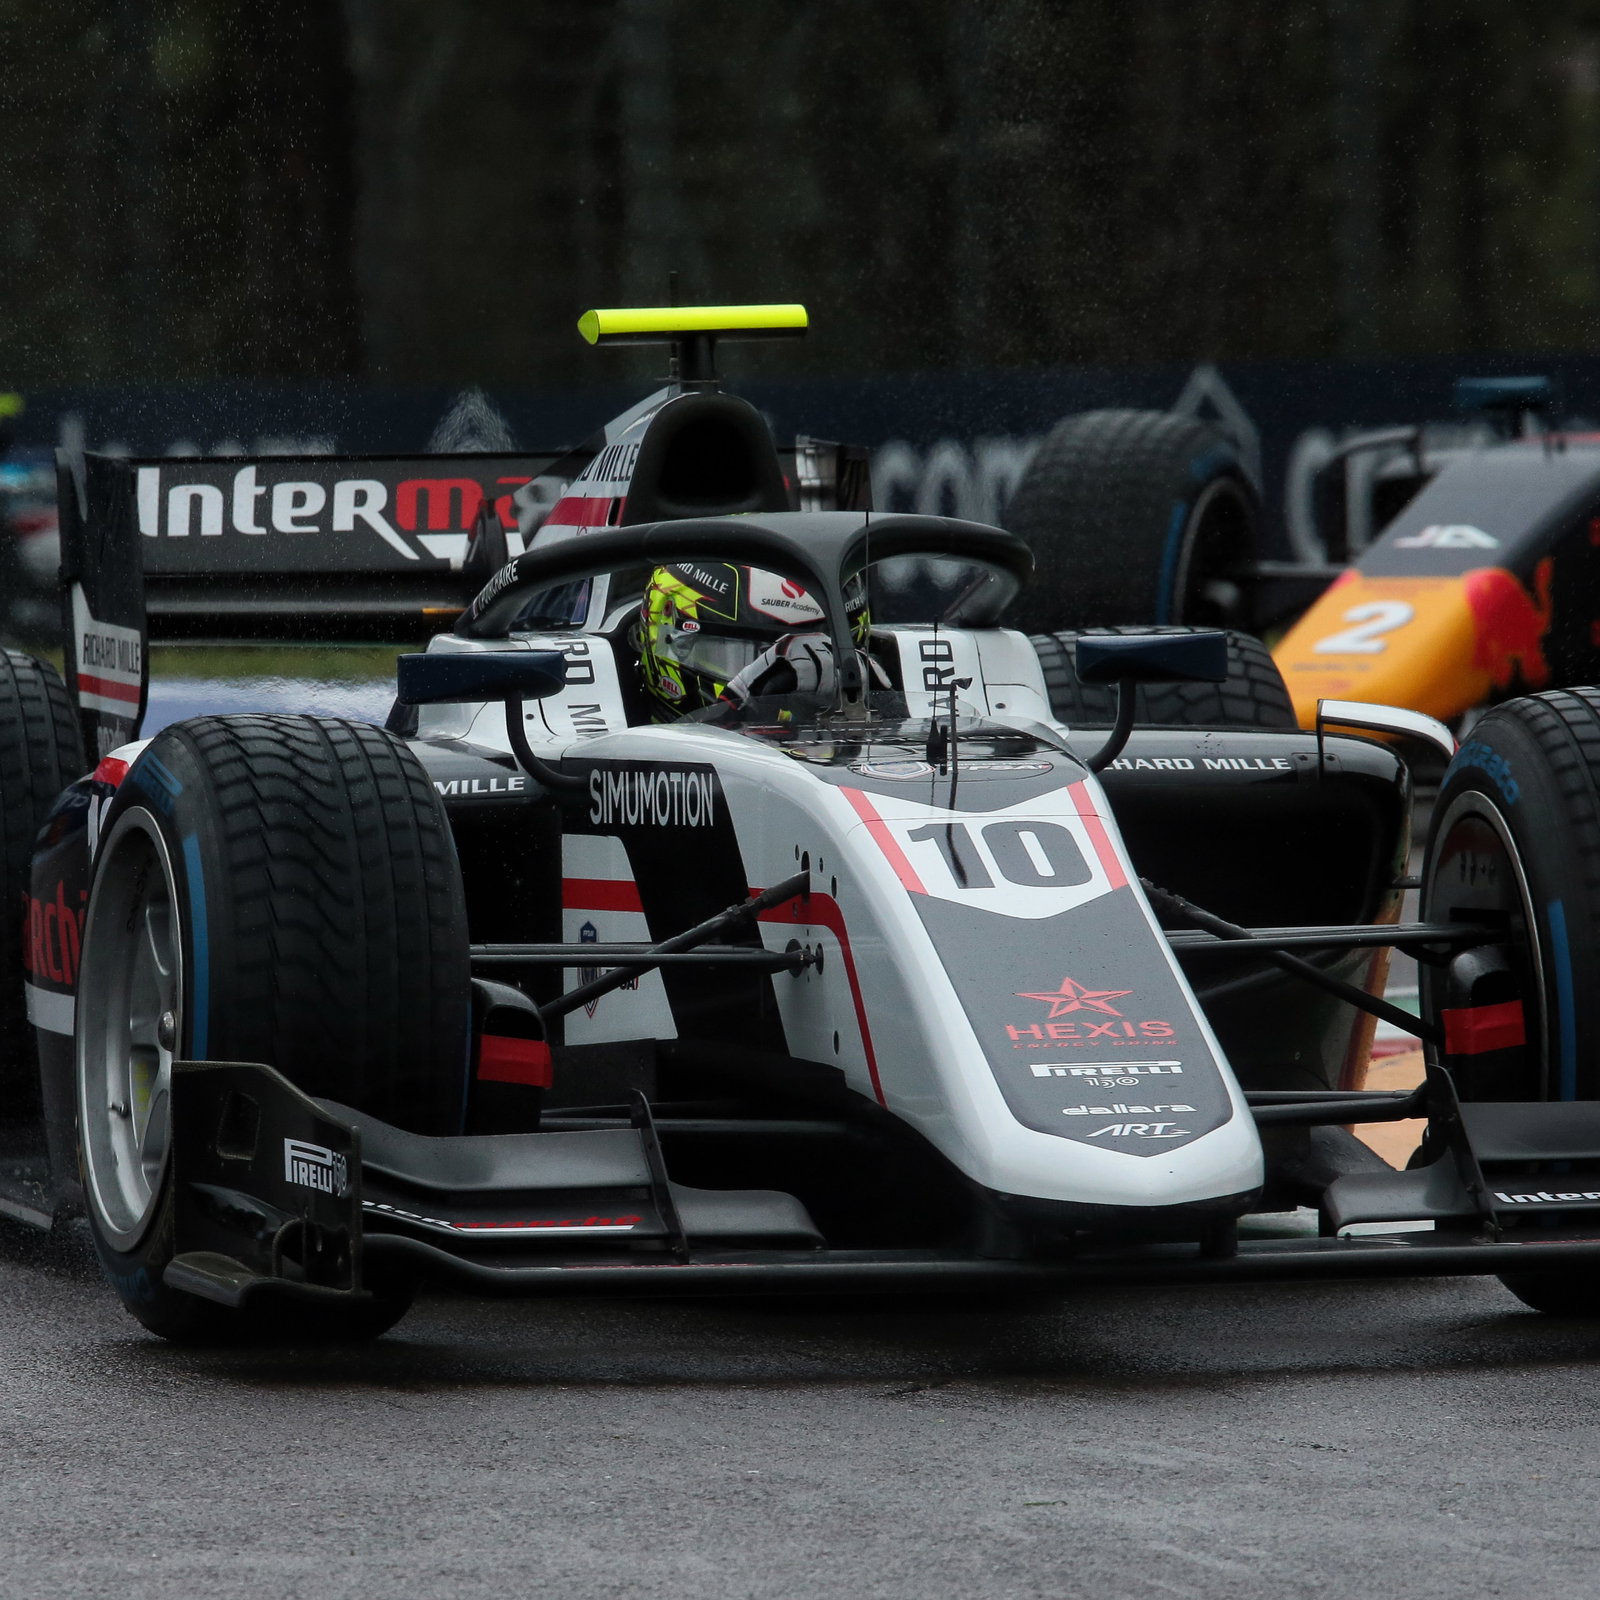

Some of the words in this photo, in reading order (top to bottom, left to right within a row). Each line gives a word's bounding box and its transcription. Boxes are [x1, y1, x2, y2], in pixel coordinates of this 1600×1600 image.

[592, 444, 640, 482] MILLE
[692, 568, 729, 594] MILLE
[761, 598, 790, 608] SAUBER
[791, 601, 820, 615] Academy
[683, 623, 699, 631] BELL
[1313, 600, 1415, 654] 2
[83, 633, 115, 668] RICHARD
[662, 679, 680, 694] BELL
[1201, 758, 1292, 770] MILLE
[433, 777, 525, 796] MILLE
[589, 769, 714, 827] SIMUMOTION
[907, 820, 1093, 889] 10
[1005, 1021, 1176, 1041] HEXIS
[1013, 1041, 1100, 1049] ENERGY
[1029, 1060, 1184, 1078] PIRELLI
[1062, 1104, 1198, 1115] dallara
[1086, 1122, 1178, 1138] ART
[284, 1138, 333, 1194] PIRELLI
